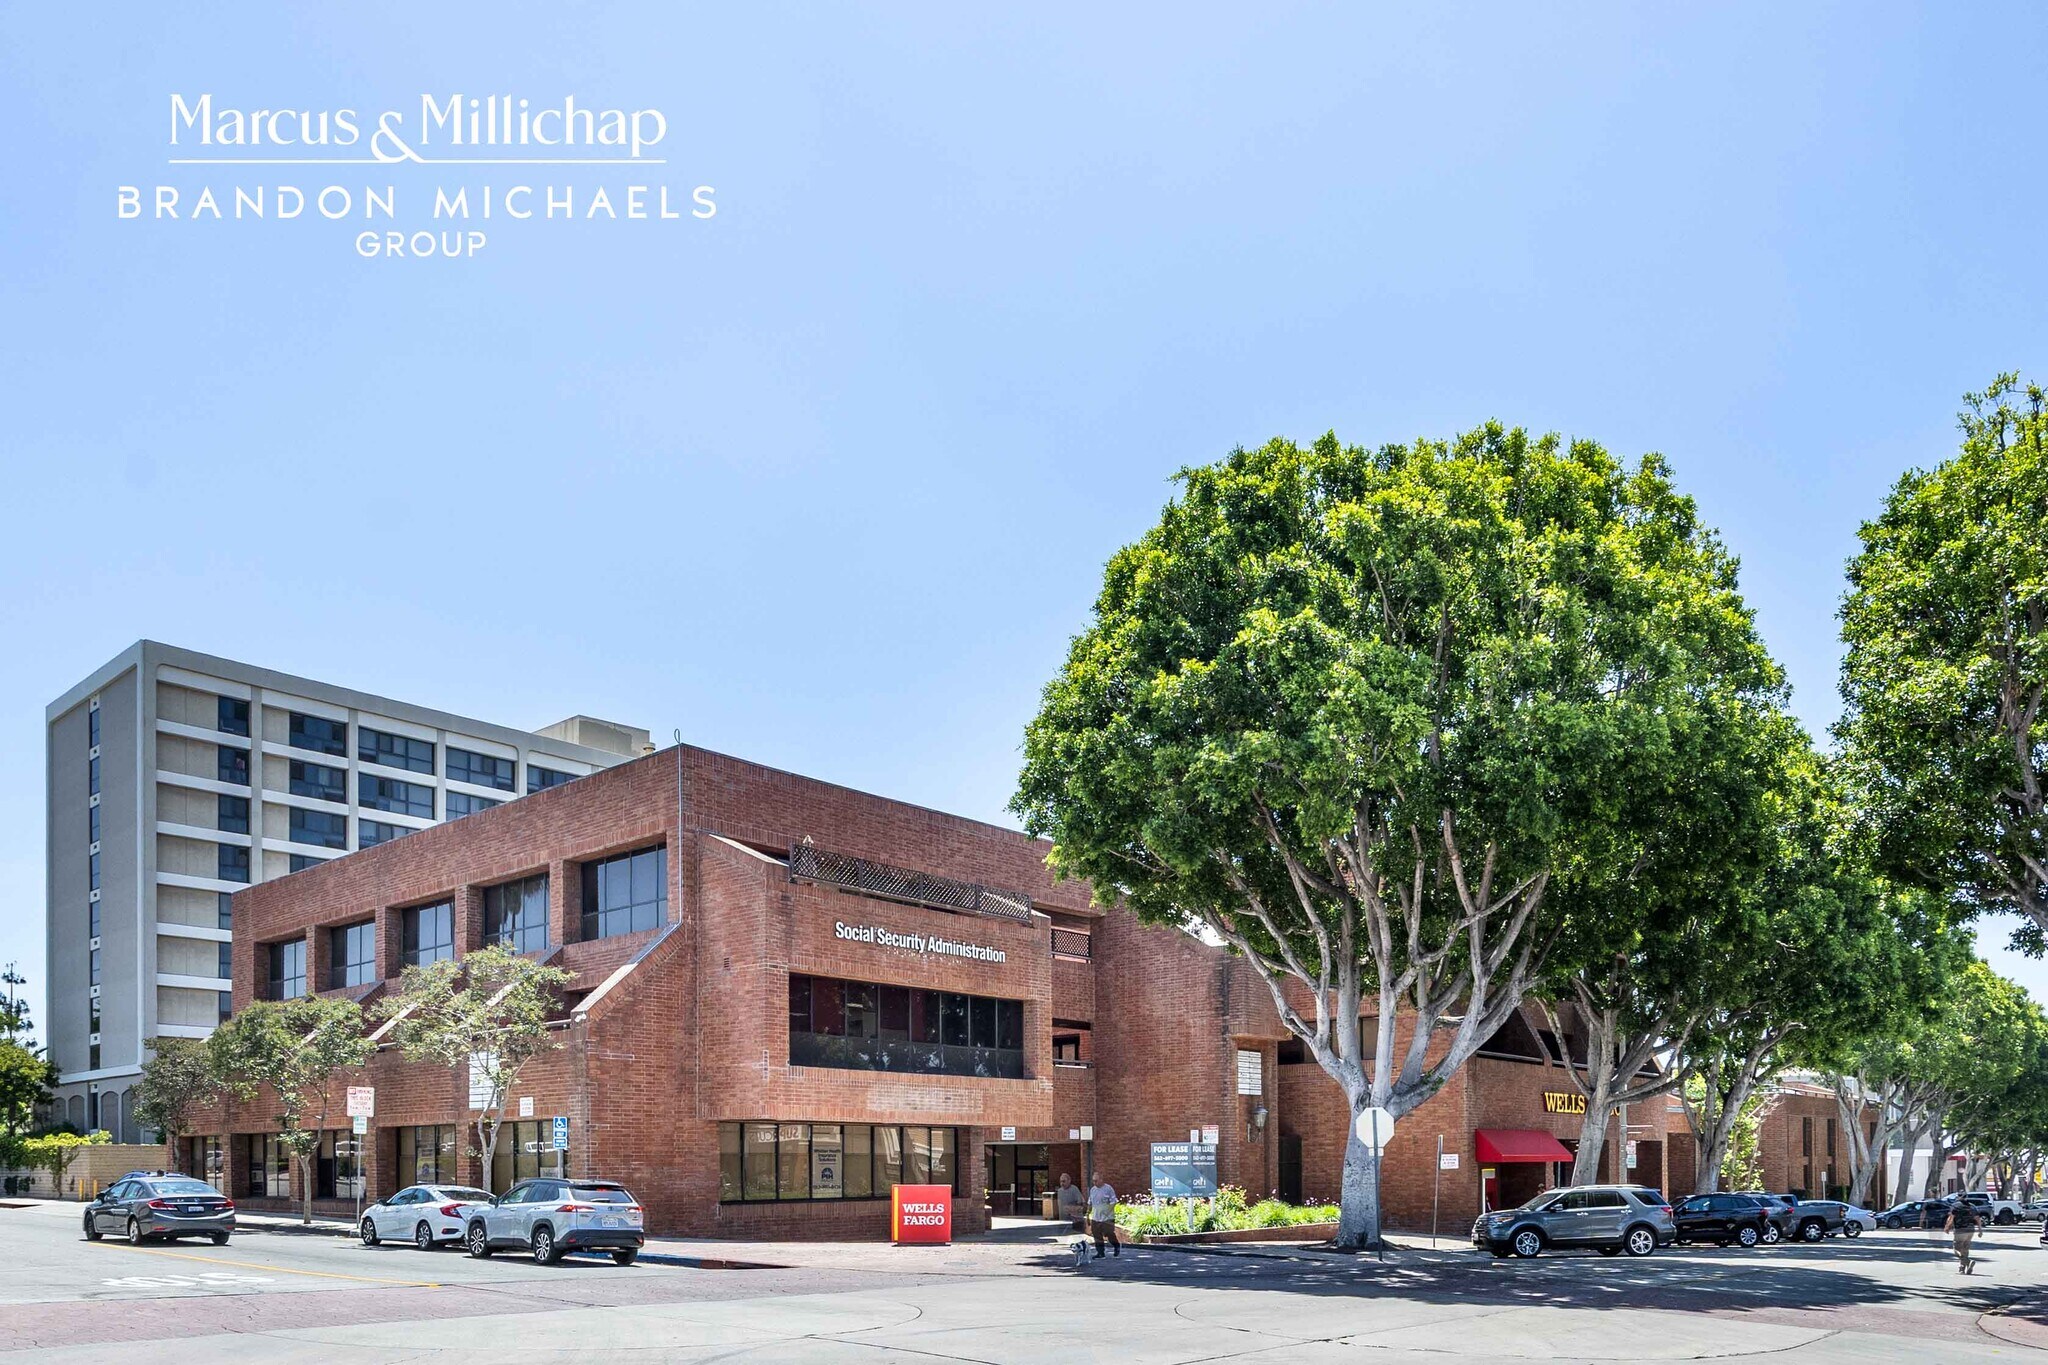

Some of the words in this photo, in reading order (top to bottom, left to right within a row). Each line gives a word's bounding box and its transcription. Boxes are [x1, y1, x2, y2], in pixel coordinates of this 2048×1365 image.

[835, 921, 874, 943] Social
[876, 928, 926, 953] Security
[927, 936, 1006, 963] Administration
[1544, 1092, 1586, 1114] WELLS
[1192, 1145, 1201, 1153] FOR
[1202, 1145, 1215, 1153] LEASE
[902, 1203, 945, 1214] WELLS
[903, 1215, 945, 1226] FARGO
